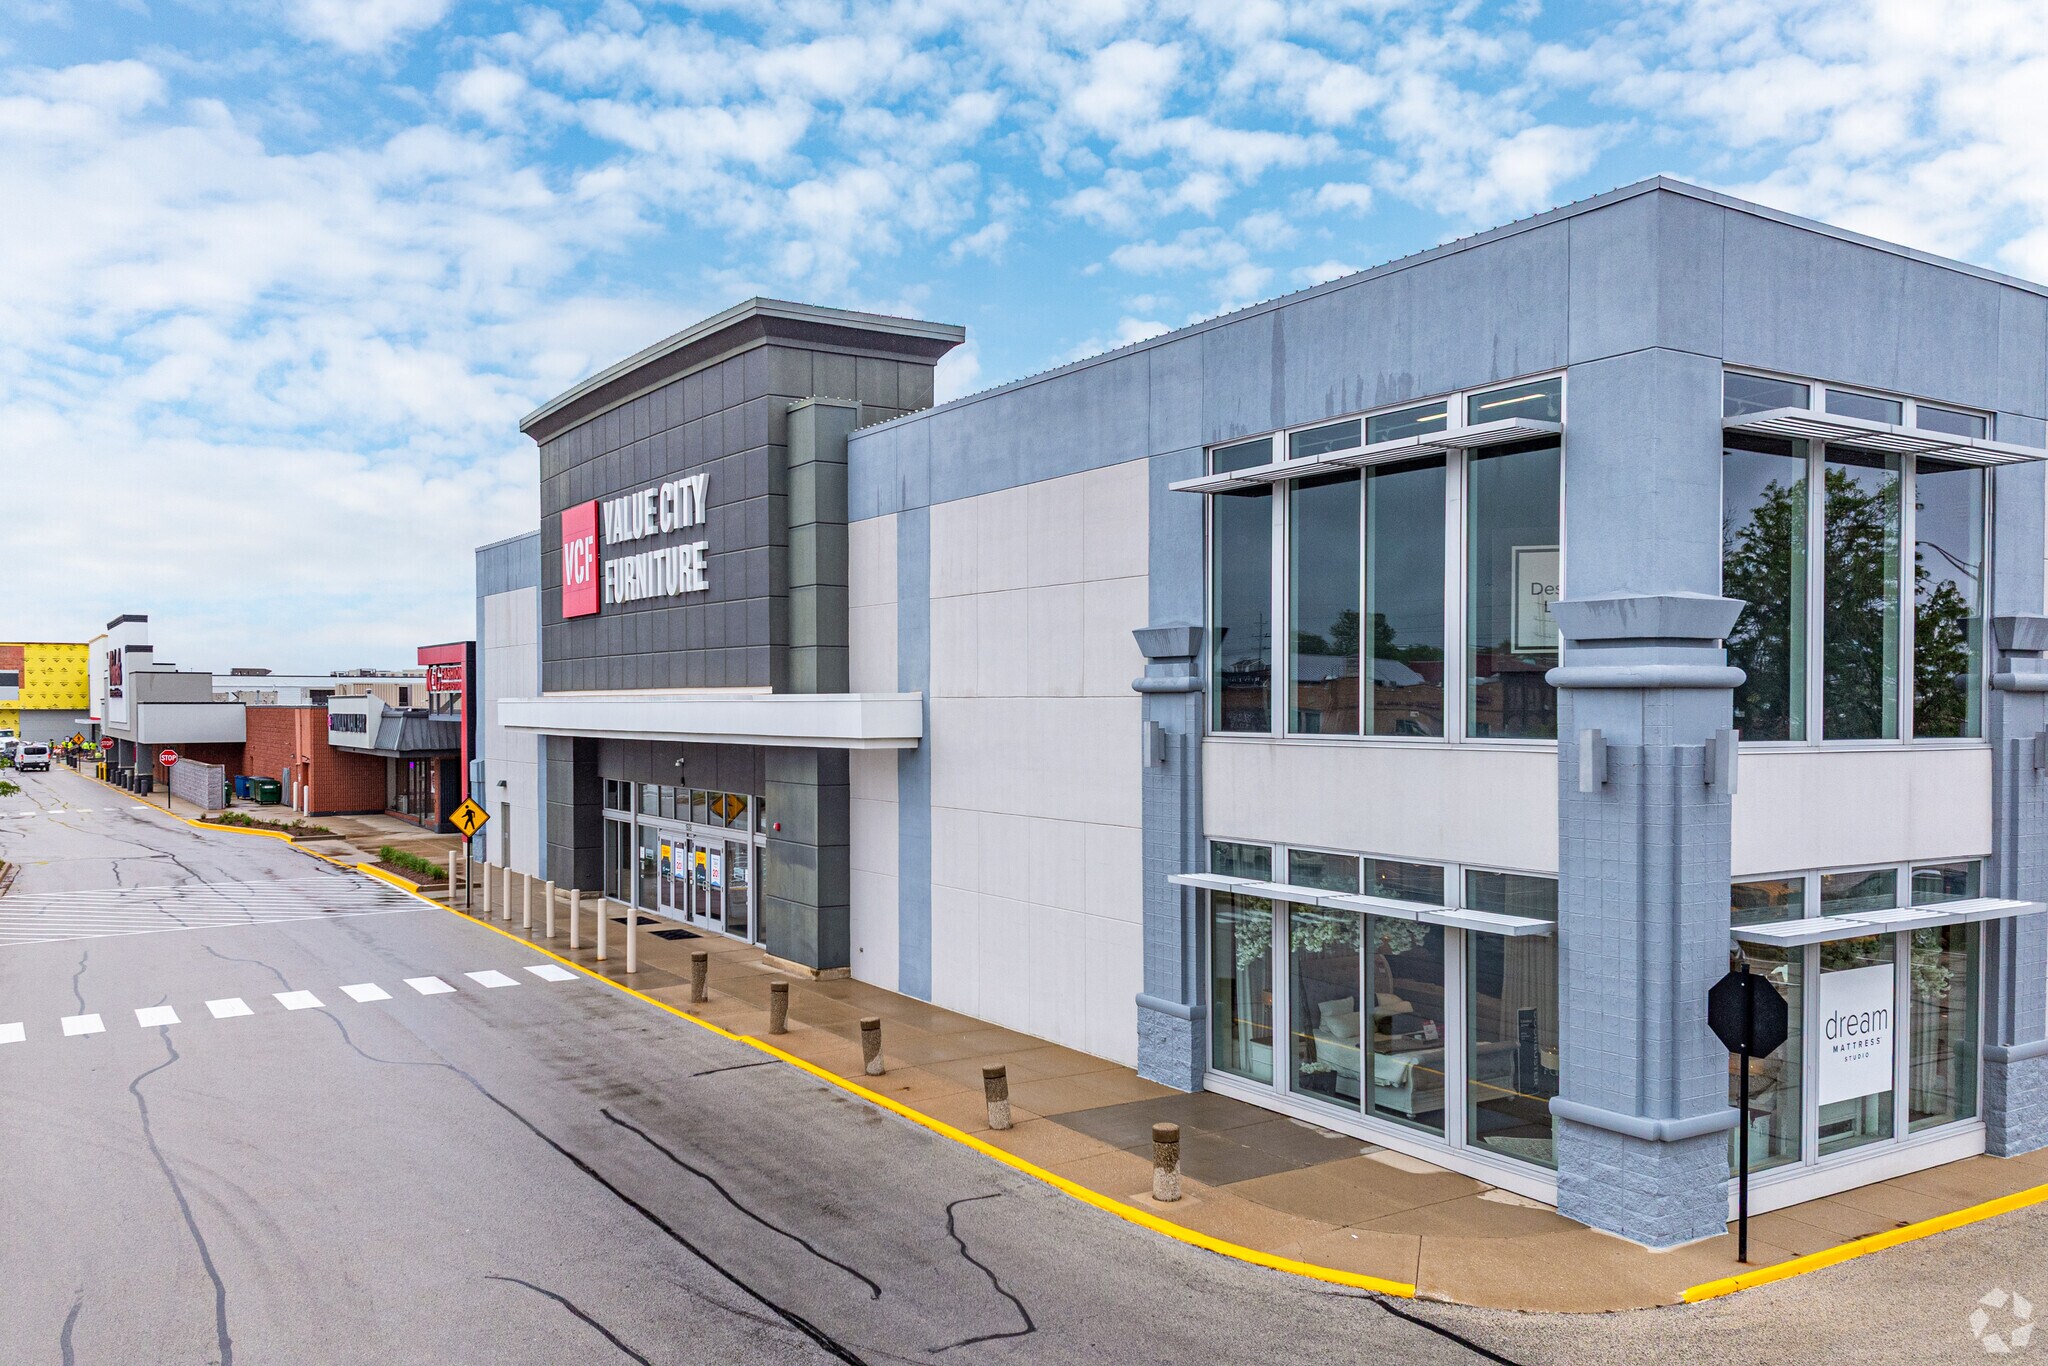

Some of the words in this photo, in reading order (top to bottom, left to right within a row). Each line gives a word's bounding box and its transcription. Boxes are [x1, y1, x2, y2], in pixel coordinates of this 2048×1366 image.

[603, 487, 658, 545] VALUE
[659, 473, 709, 533] CITY
[564, 535, 594, 586] VCF
[604, 540, 709, 604] FURNITURE
[161, 754, 177, 762] STOP
[1825, 1008, 1888, 1040] dream
[1833, 1037, 1881, 1053] MATTRESS
[1844, 1052, 1870, 1062] STUDIO
